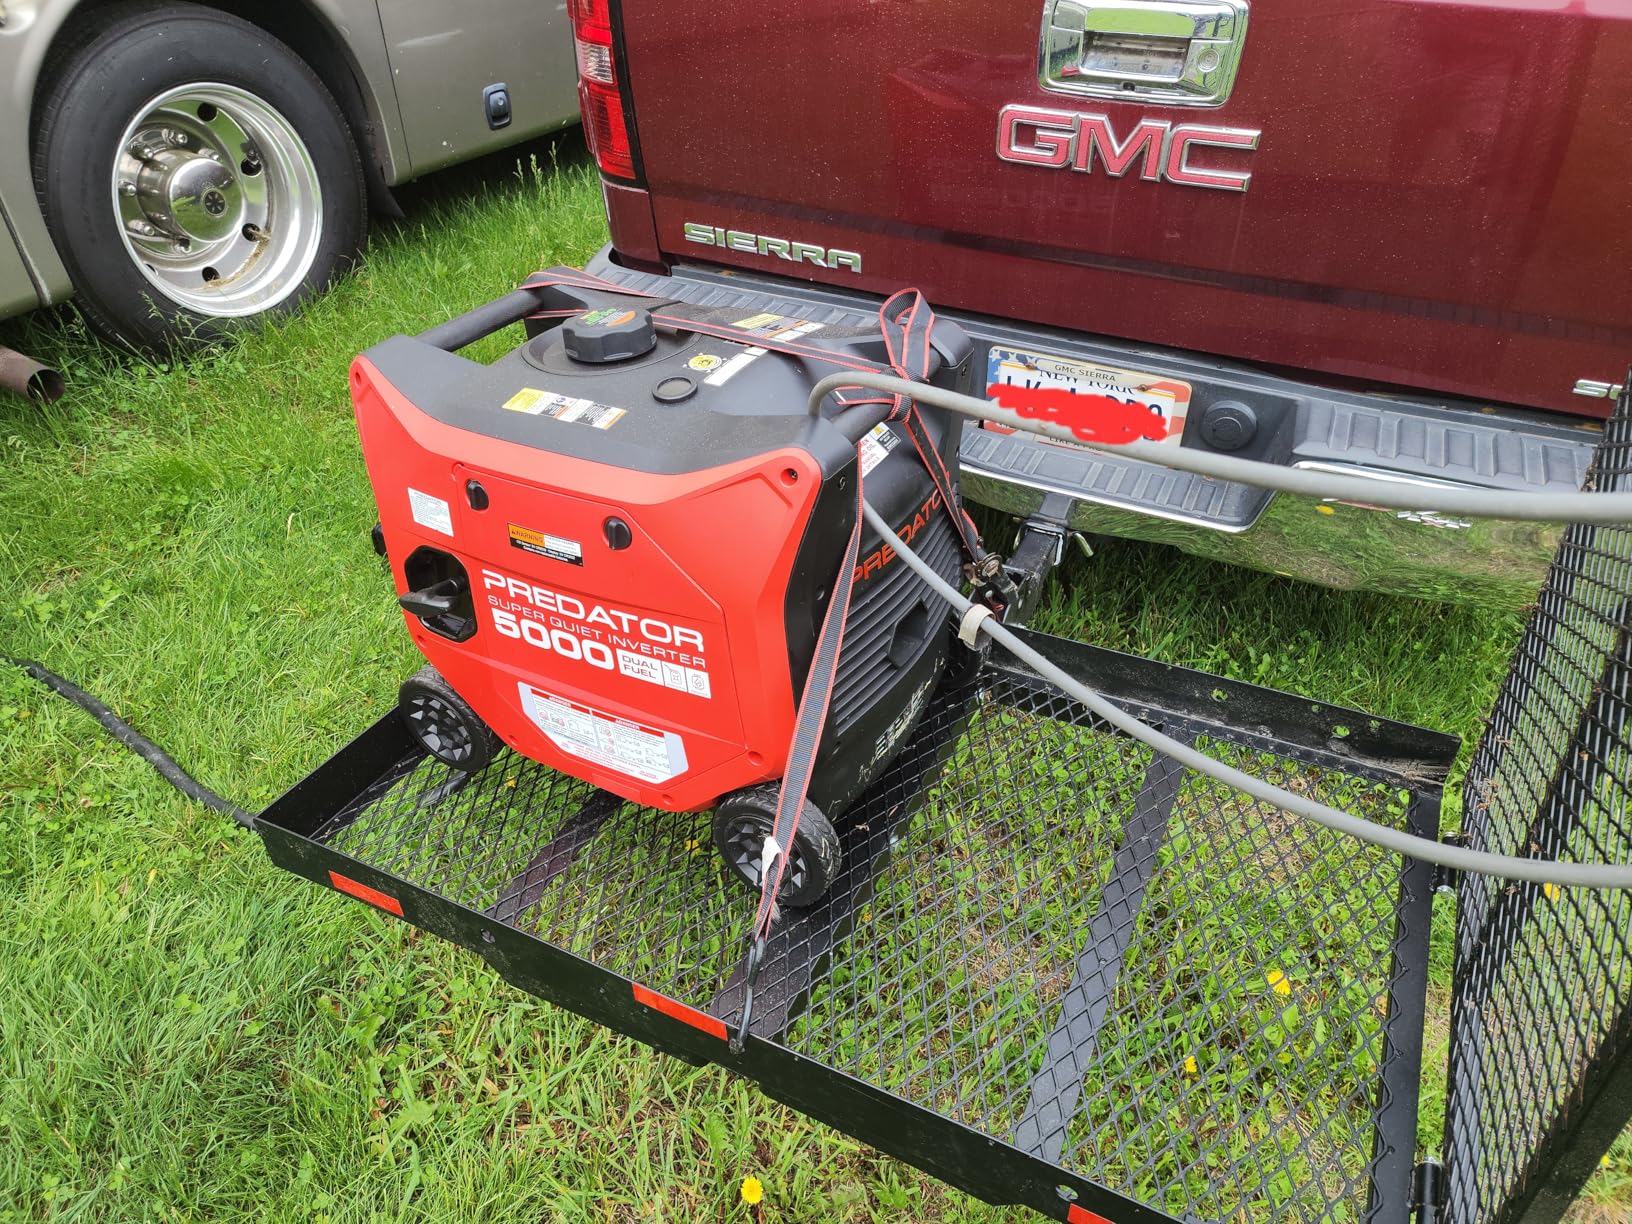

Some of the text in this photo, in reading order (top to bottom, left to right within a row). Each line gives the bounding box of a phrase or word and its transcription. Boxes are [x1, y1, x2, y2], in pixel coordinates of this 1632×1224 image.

[996, 103, 1262, 192] GMC
[684, 222, 862, 273] SIERRA
[1054, 364, 1116, 382] GMC SIERRA
[482, 569, 705, 653] PREDATOR
[487, 595, 706, 669] SUPER QUIET INVERTER
[491, 608, 615, 671] 5000
[622, 655, 658, 671] DUAL
[624, 664, 657, 679] FUEL
